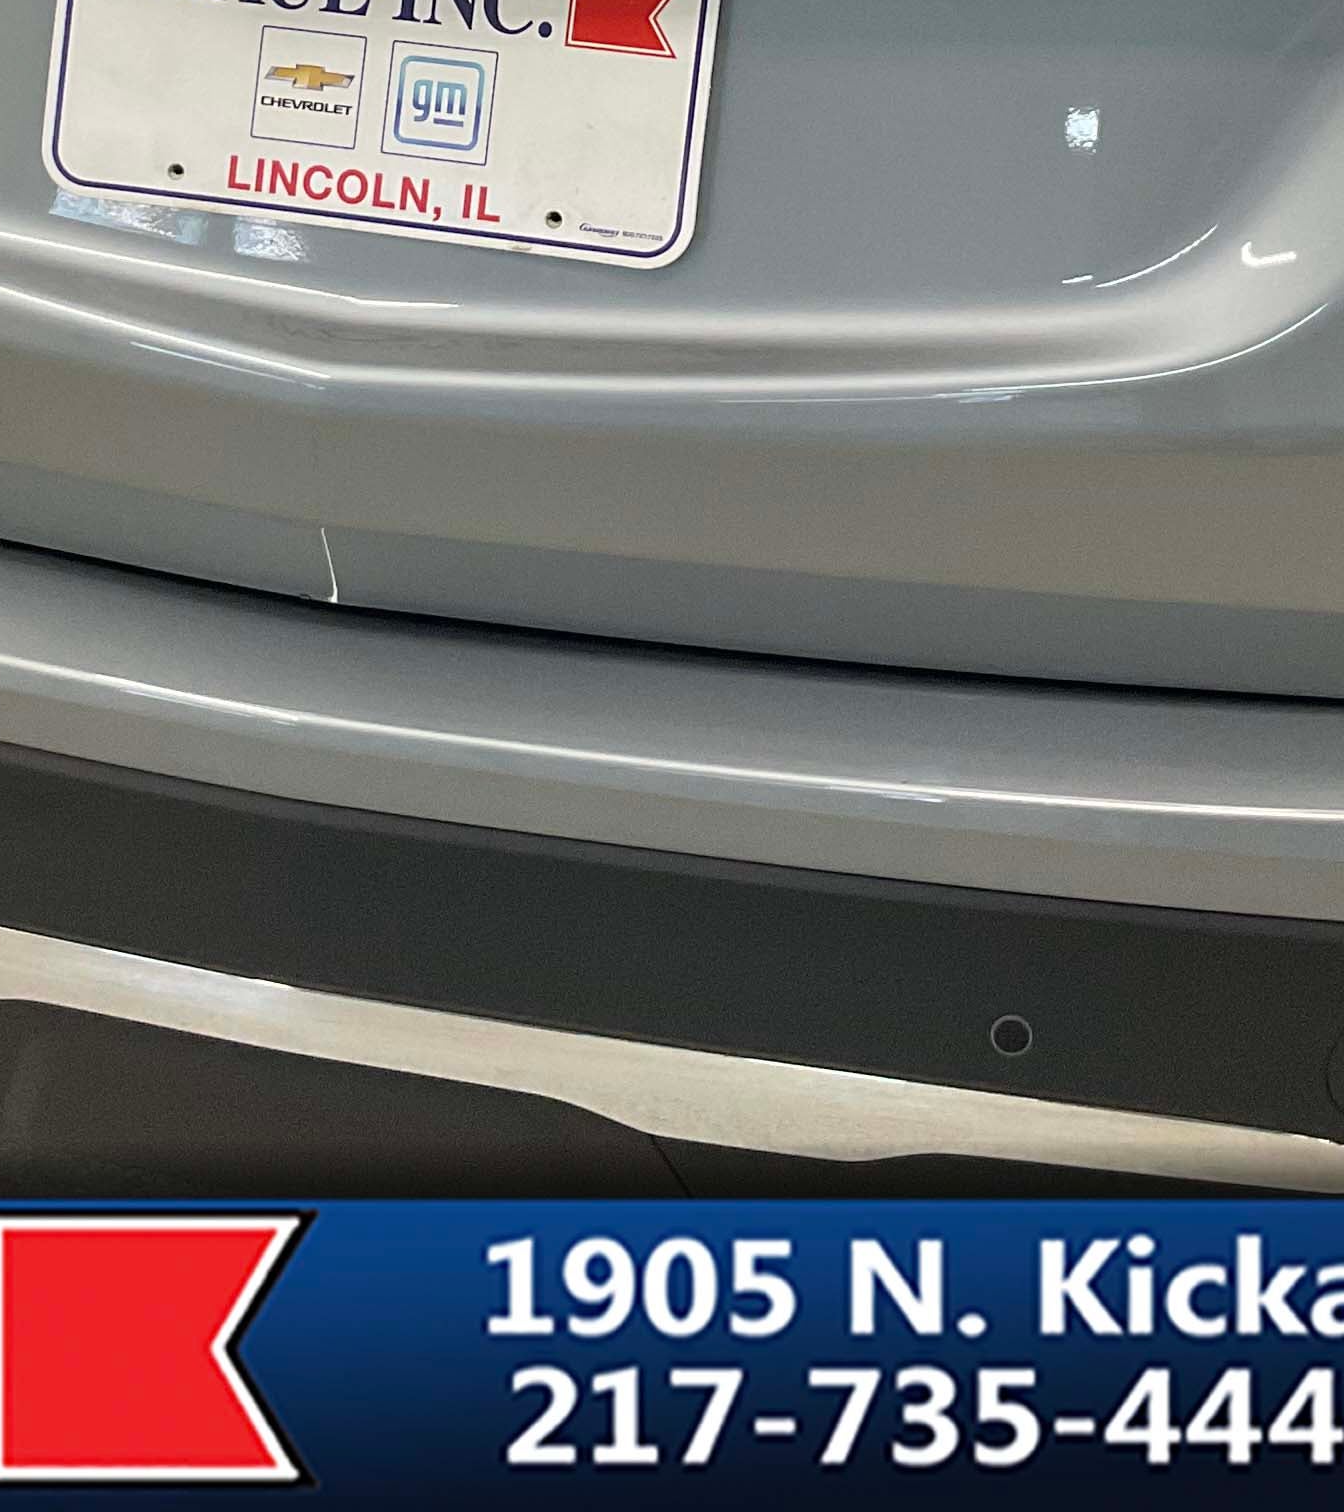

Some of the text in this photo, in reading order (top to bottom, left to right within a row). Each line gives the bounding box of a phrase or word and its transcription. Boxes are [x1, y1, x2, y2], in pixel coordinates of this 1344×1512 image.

[260, 95, 353, 116] CHEVROLET
[412, 79, 468, 128] gm
[227, 155, 501, 223] LINCOLN, IL
